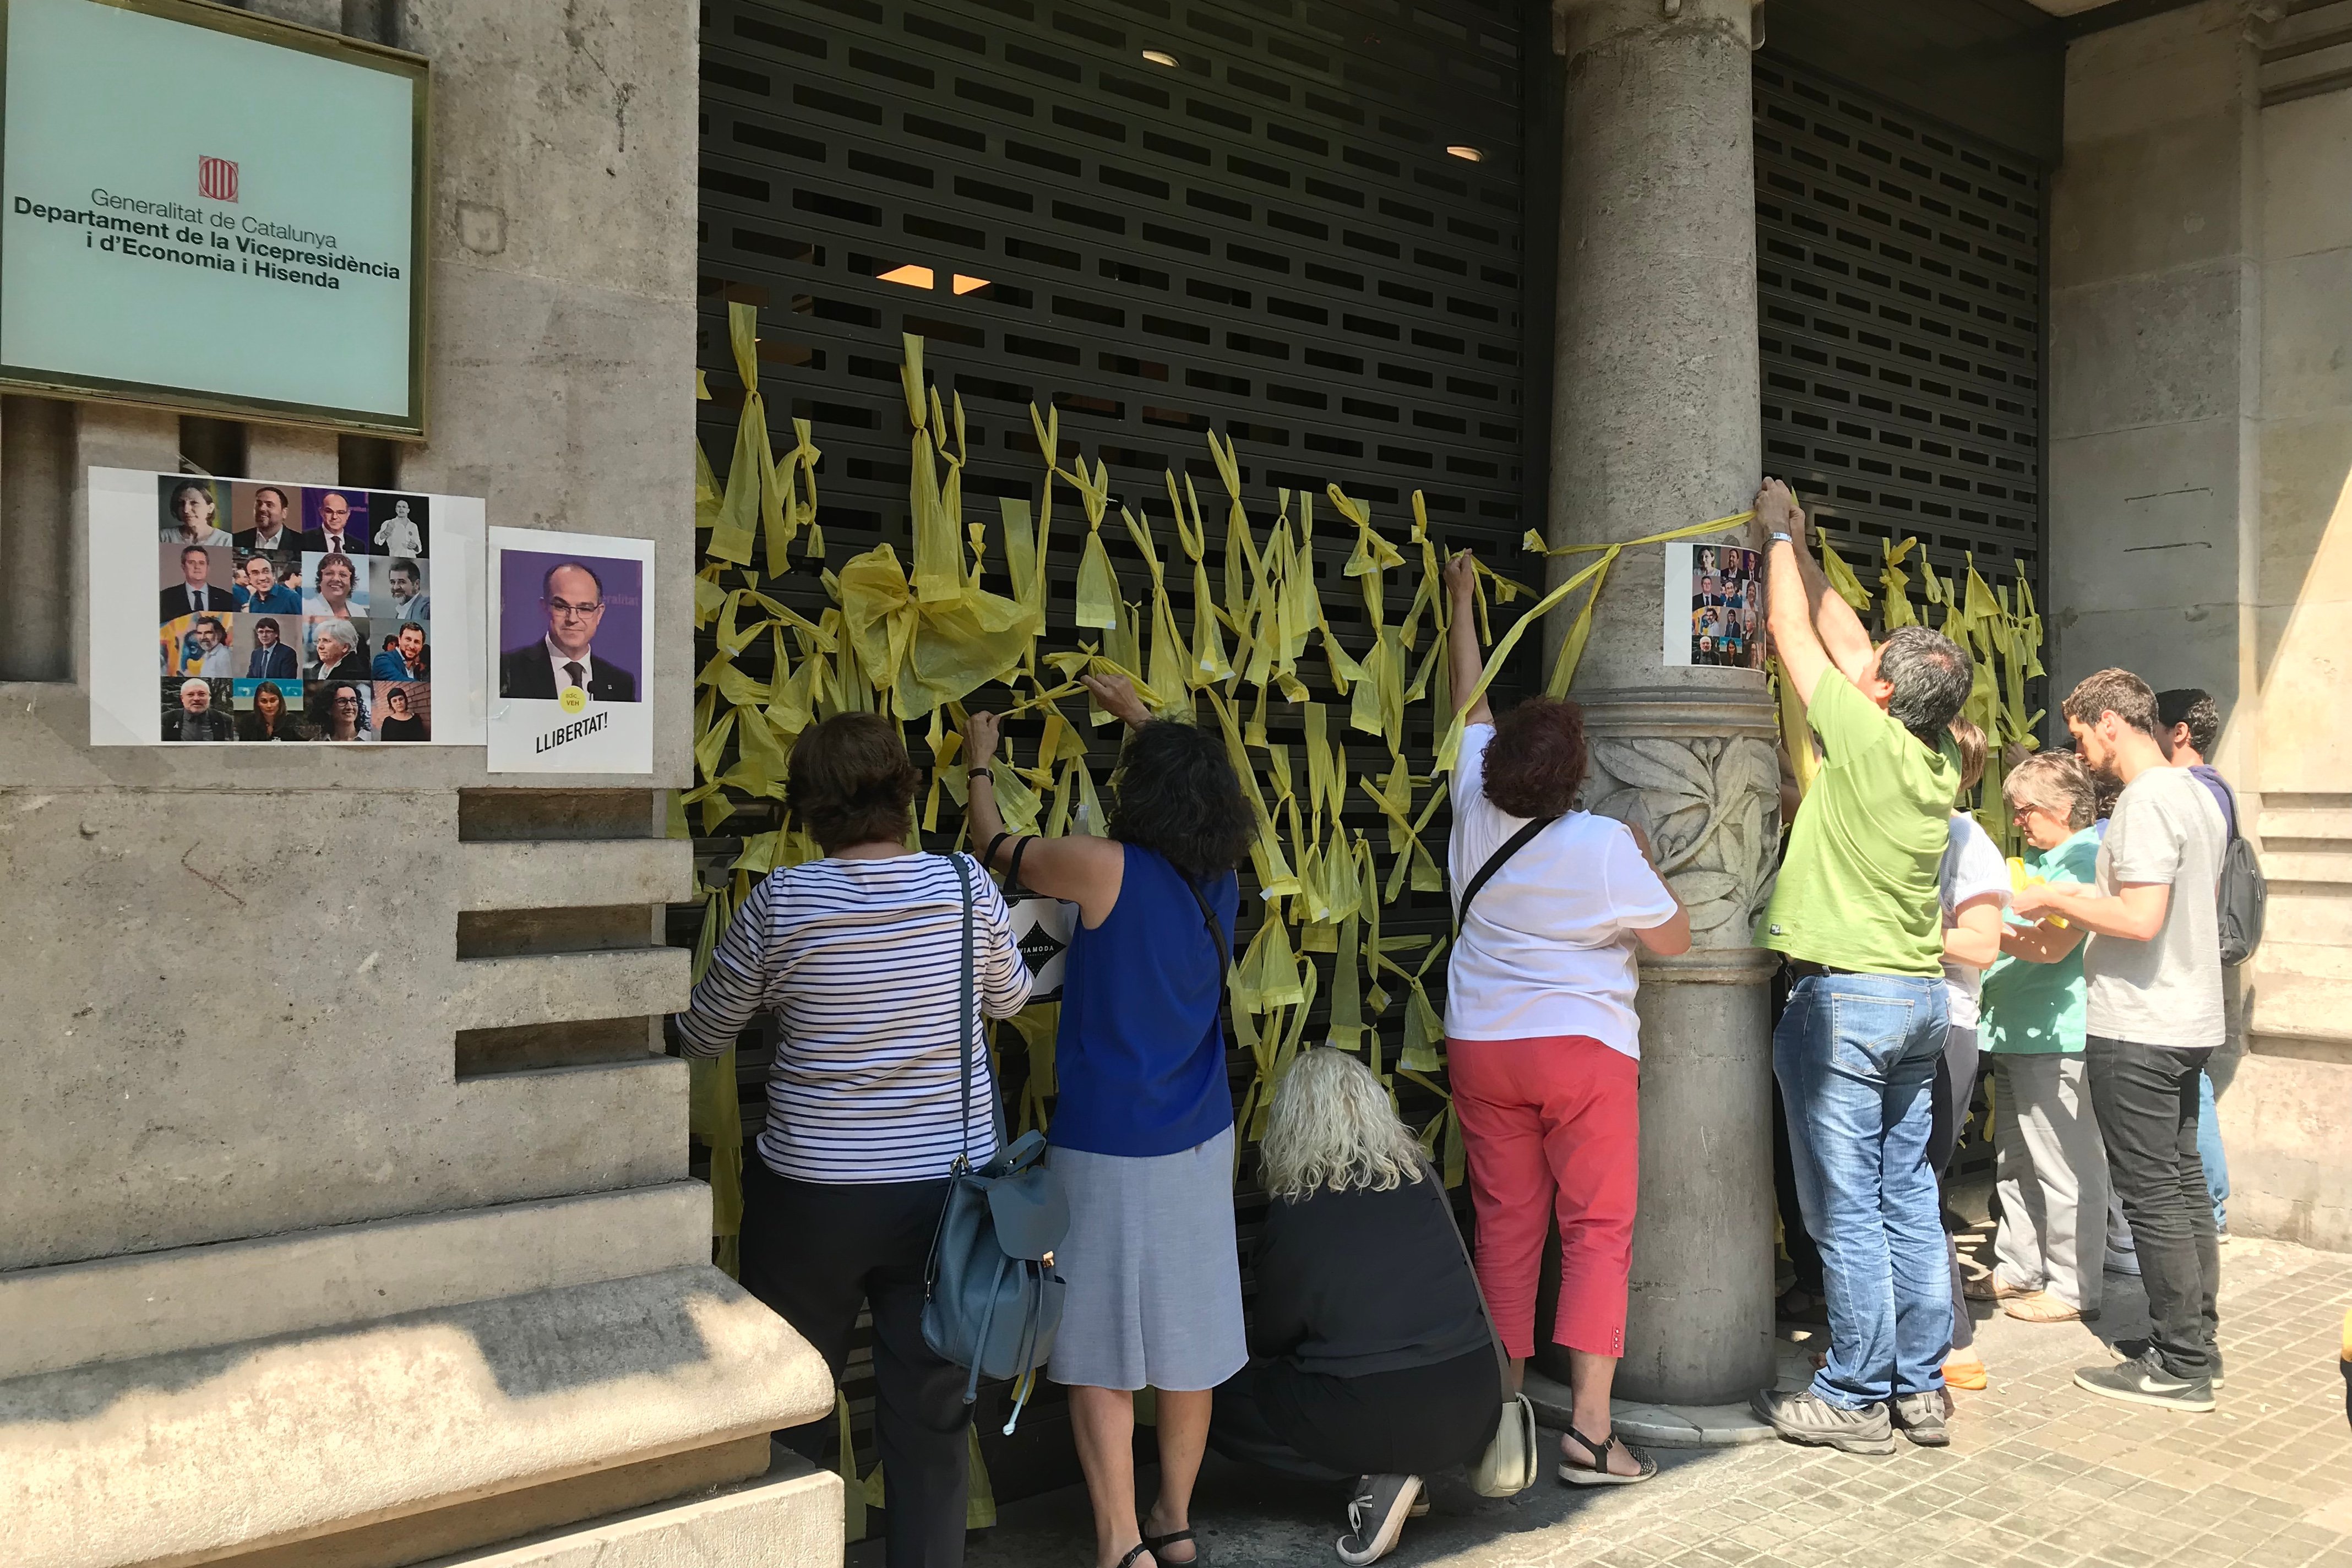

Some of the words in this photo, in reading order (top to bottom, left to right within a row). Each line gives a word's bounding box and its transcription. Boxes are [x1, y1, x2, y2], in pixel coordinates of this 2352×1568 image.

[14, 195, 170, 240] Departament
[176, 226, 204, 246] de
[210, 231, 229, 250] la
[235, 235, 400, 280] Vicepresidència
[91, 188, 203, 224] Generalitat
[210, 211, 235, 230] de
[242, 216, 337, 249] Catalunya
[86, 231, 92, 248] i
[242, 258, 247, 274] i
[254, 260, 340, 290] Hisenda
[536, 711, 608, 754] LLIBERTAT!
